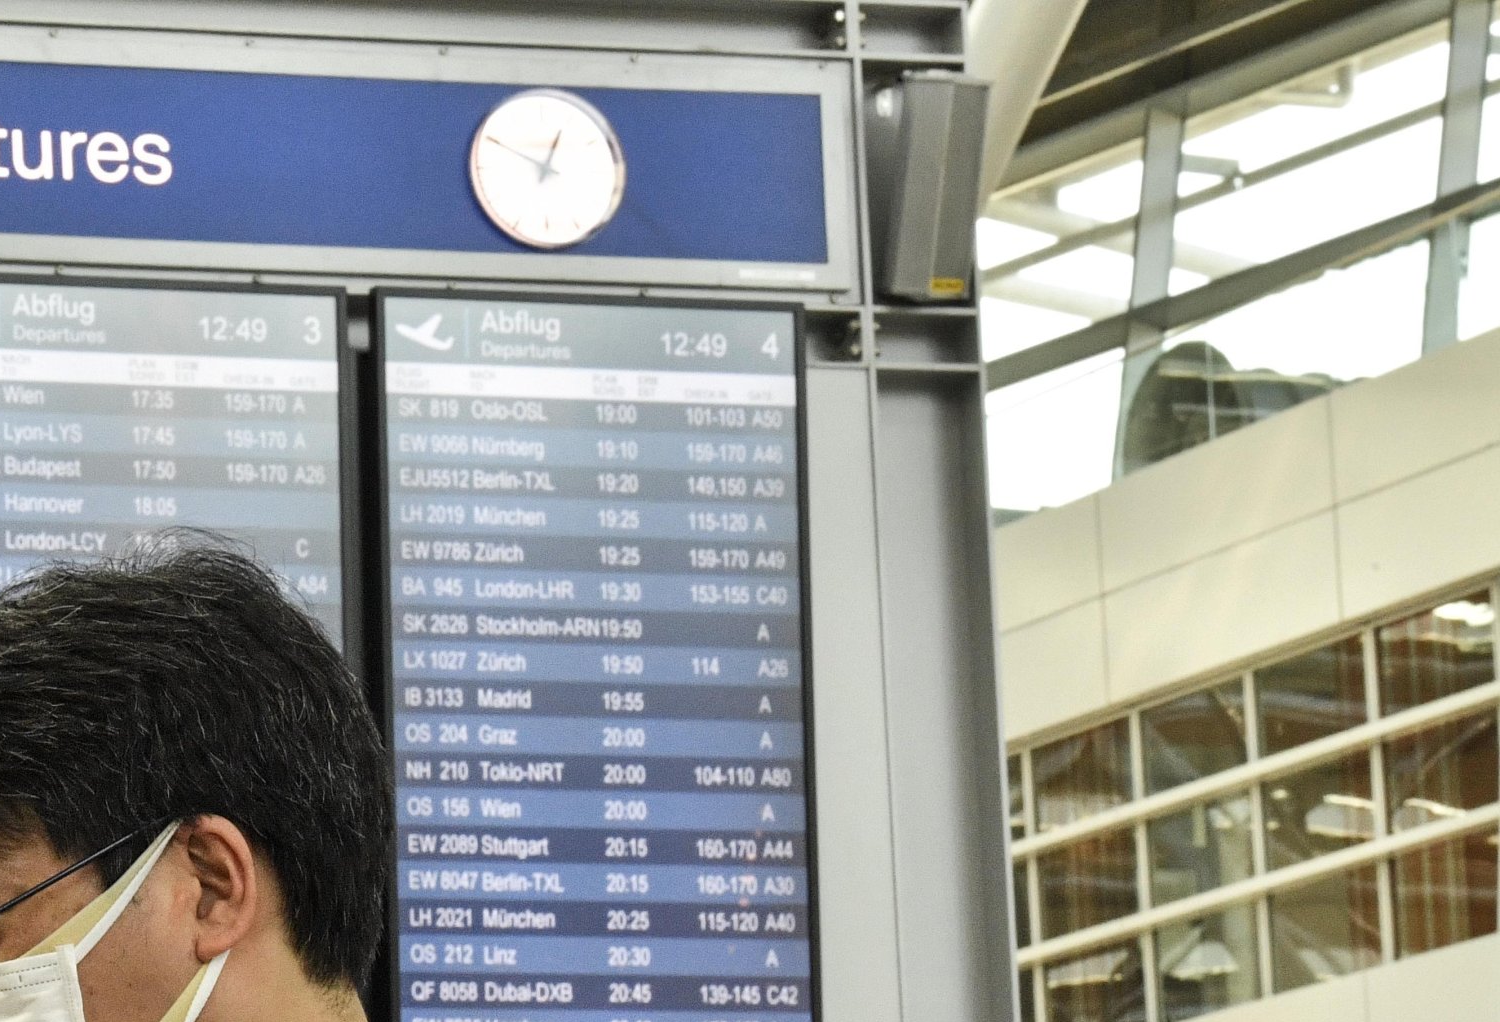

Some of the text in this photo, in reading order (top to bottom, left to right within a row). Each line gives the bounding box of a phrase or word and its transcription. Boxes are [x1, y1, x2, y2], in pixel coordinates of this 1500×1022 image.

[13, 293, 95, 326] Abflug
[13, 323, 106, 344] Departures
[200, 316, 322, 344] 12:49 3
[481, 310, 561, 341] Abflug
[481, 341, 571, 360] Departures
[661, 333, 778, 360] 12:49 4
[5, 386, 44, 405] Wien
[132, 390, 174, 409] 17:35
[225, 393, 285, 412] 159-170
[293, 397, 305, 413] A
[5, 457, 81, 480] Budapest
[134, 461, 175, 480] 17:50
[227, 464, 287, 483] 159-170
[406, 762, 430, 780] NH
[440, 762, 468, 780] 210
[480, 763, 564, 783] Tokio-NRT
[604, 765, 646, 784] 20:00
[695, 767, 754, 786] 104-110
[408, 835, 437, 854] EW
[482, 836, 548, 859] Stuttgart
[605, 838, 647, 857] 20:15
[763, 842, 792, 858] A44
[410, 909, 795, 932] LH 2021 München 20:25 115-120 A40
